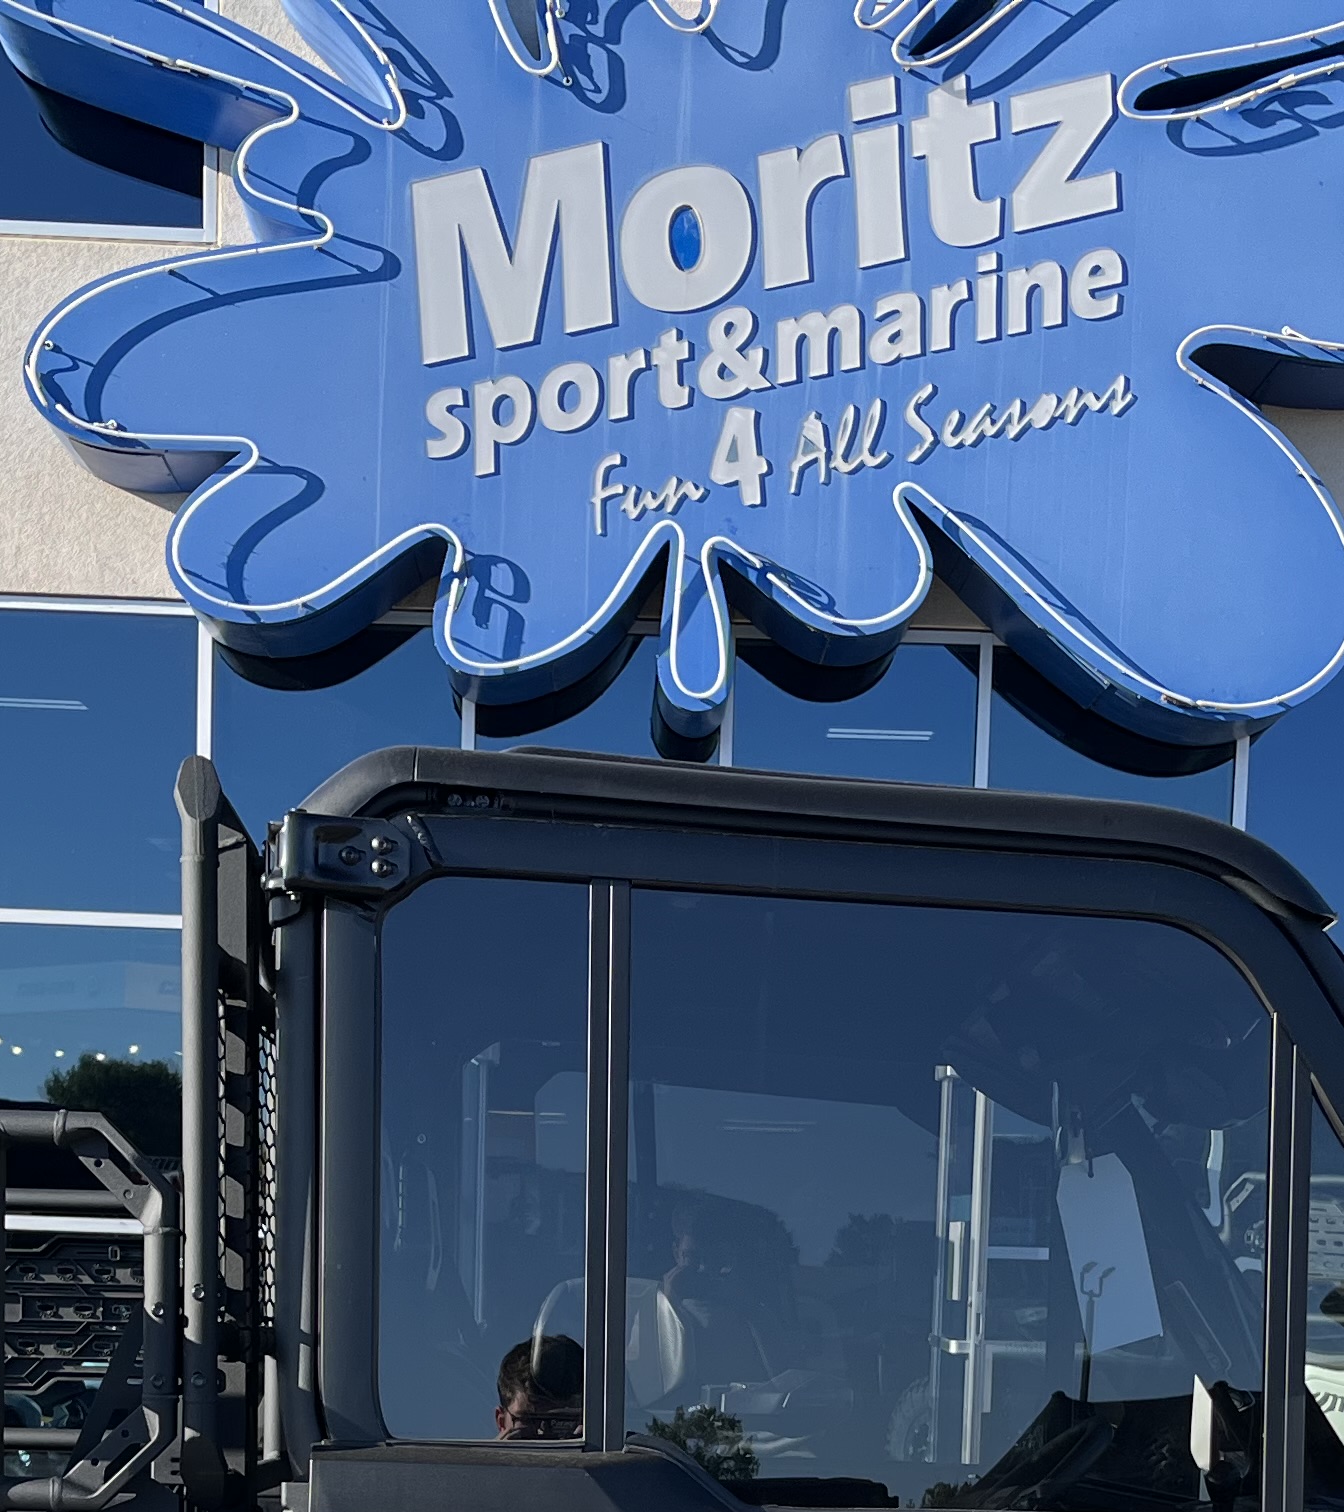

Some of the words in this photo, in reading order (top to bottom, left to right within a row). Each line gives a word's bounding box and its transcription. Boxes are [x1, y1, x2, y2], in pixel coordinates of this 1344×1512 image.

[410, 72, 1122, 367] Moritz
[424, 246, 1126, 477] sport&marine
[590, 452, 709, 536] Fun
[710, 406, 770, 507] 4
[789, 398, 893, 496] All
[904, 373, 1138, 465] Seasons
